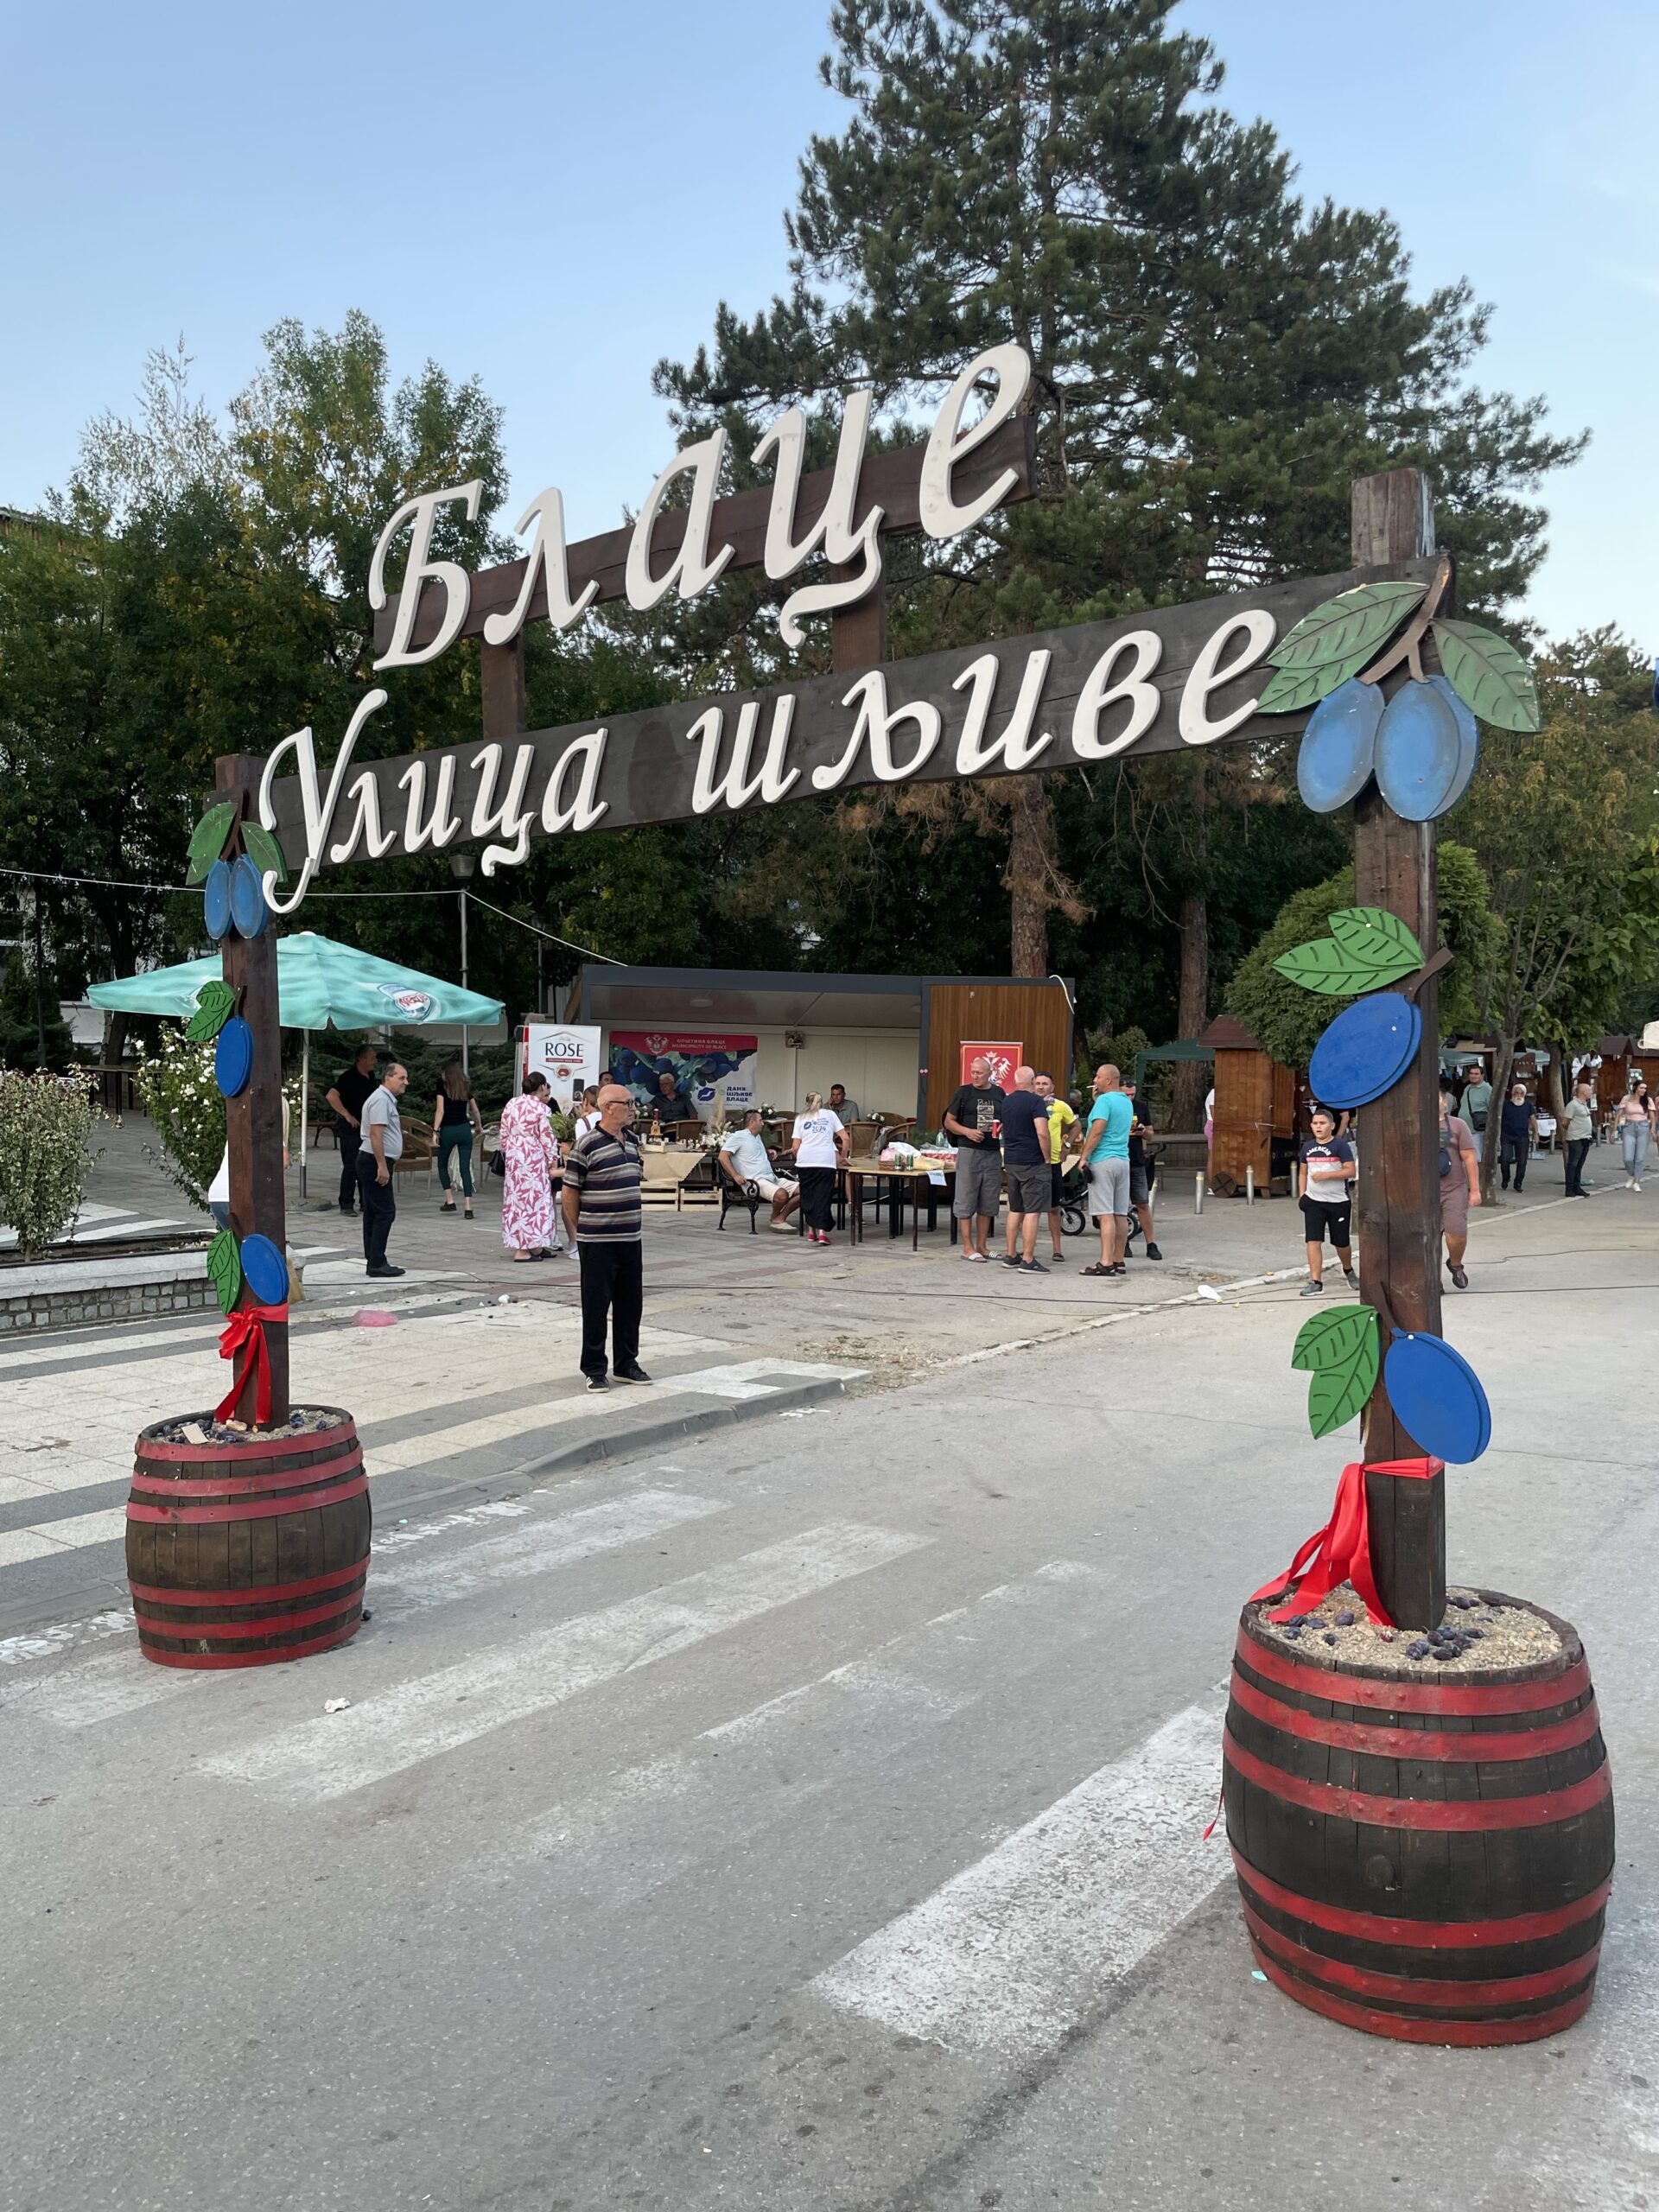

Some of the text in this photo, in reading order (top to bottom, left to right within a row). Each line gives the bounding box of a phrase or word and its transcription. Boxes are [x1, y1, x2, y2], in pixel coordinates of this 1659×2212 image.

[368, 345, 1032, 671] Блаце
[259, 609, 1276, 913] Улица шљиве
[545, 1042, 585, 1058] ROSE
